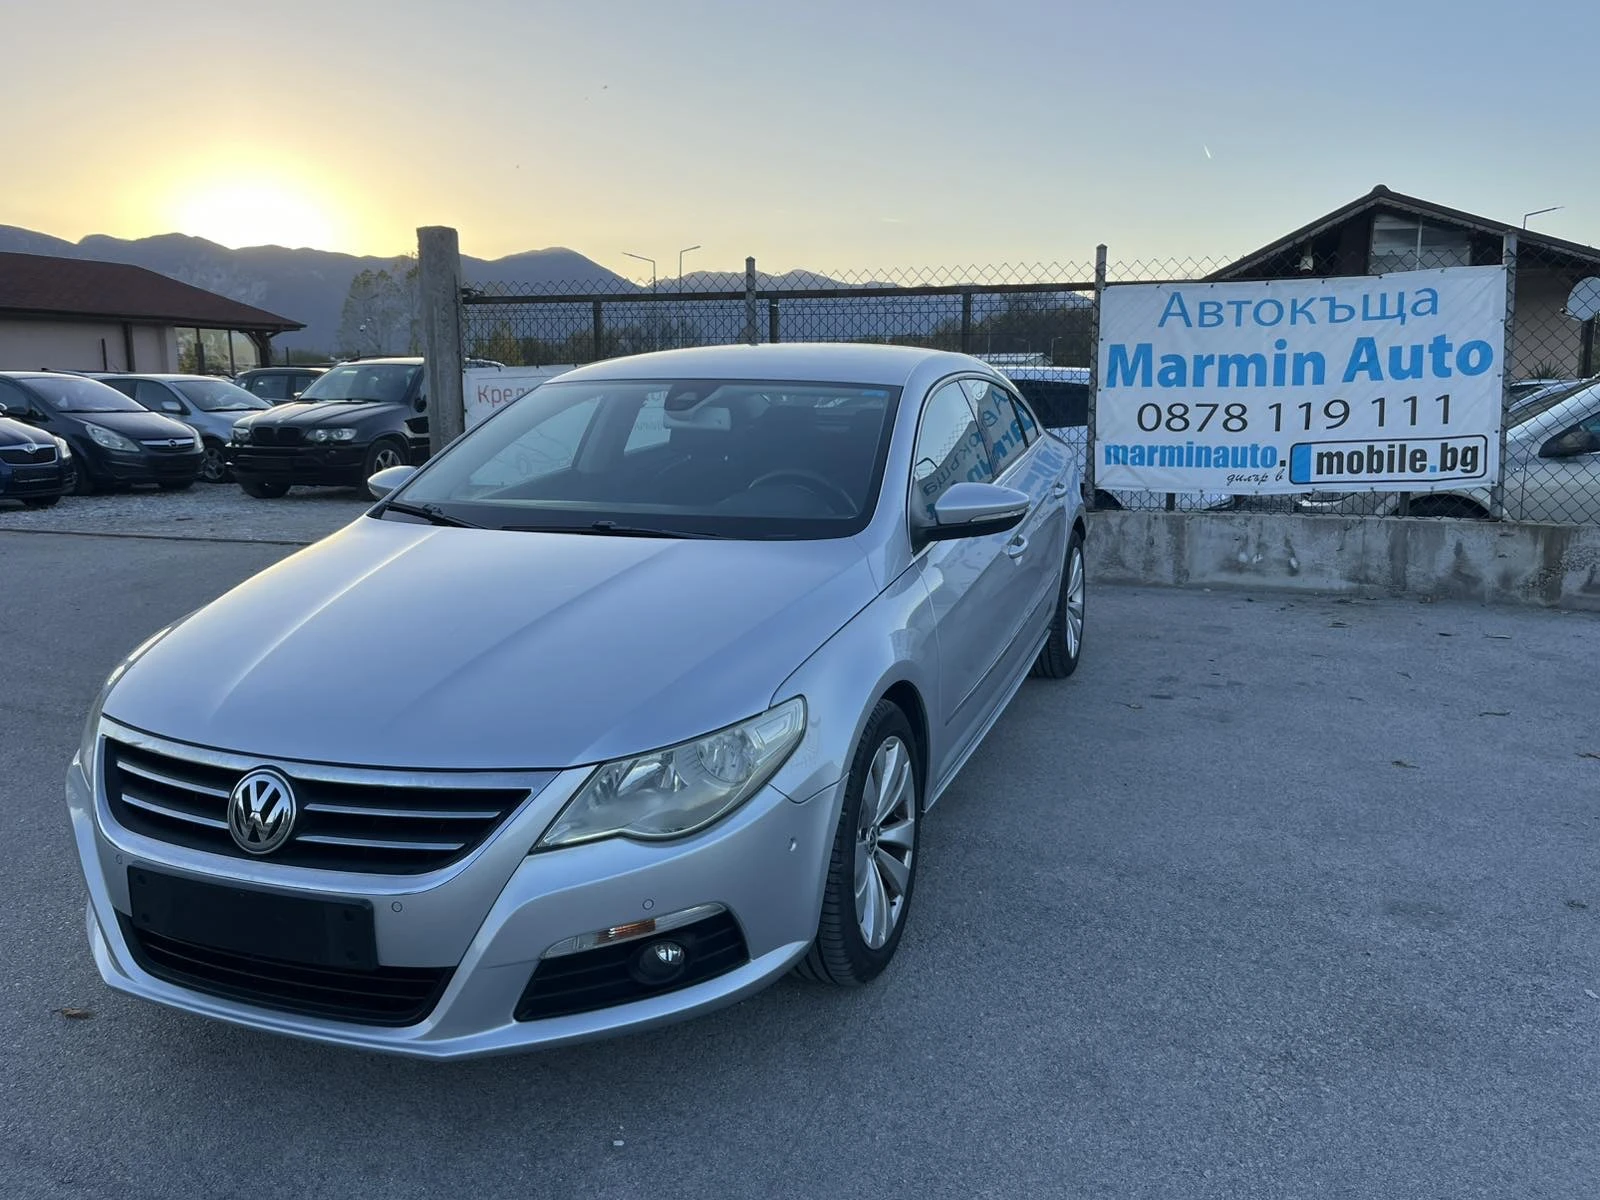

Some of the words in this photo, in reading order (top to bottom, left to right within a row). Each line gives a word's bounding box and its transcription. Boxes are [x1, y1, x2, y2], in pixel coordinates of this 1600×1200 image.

[1158, 287, 1438, 328] Автокъща
[1105, 339, 1326, 388] Marmin
[1342, 334, 1493, 383] Auto
[1137, 403, 1248, 432] 0878
[1268, 399, 1350, 432] 119
[1371, 394, 1452, 427] 111
[1316, 443, 1479, 476] mobile.bg
